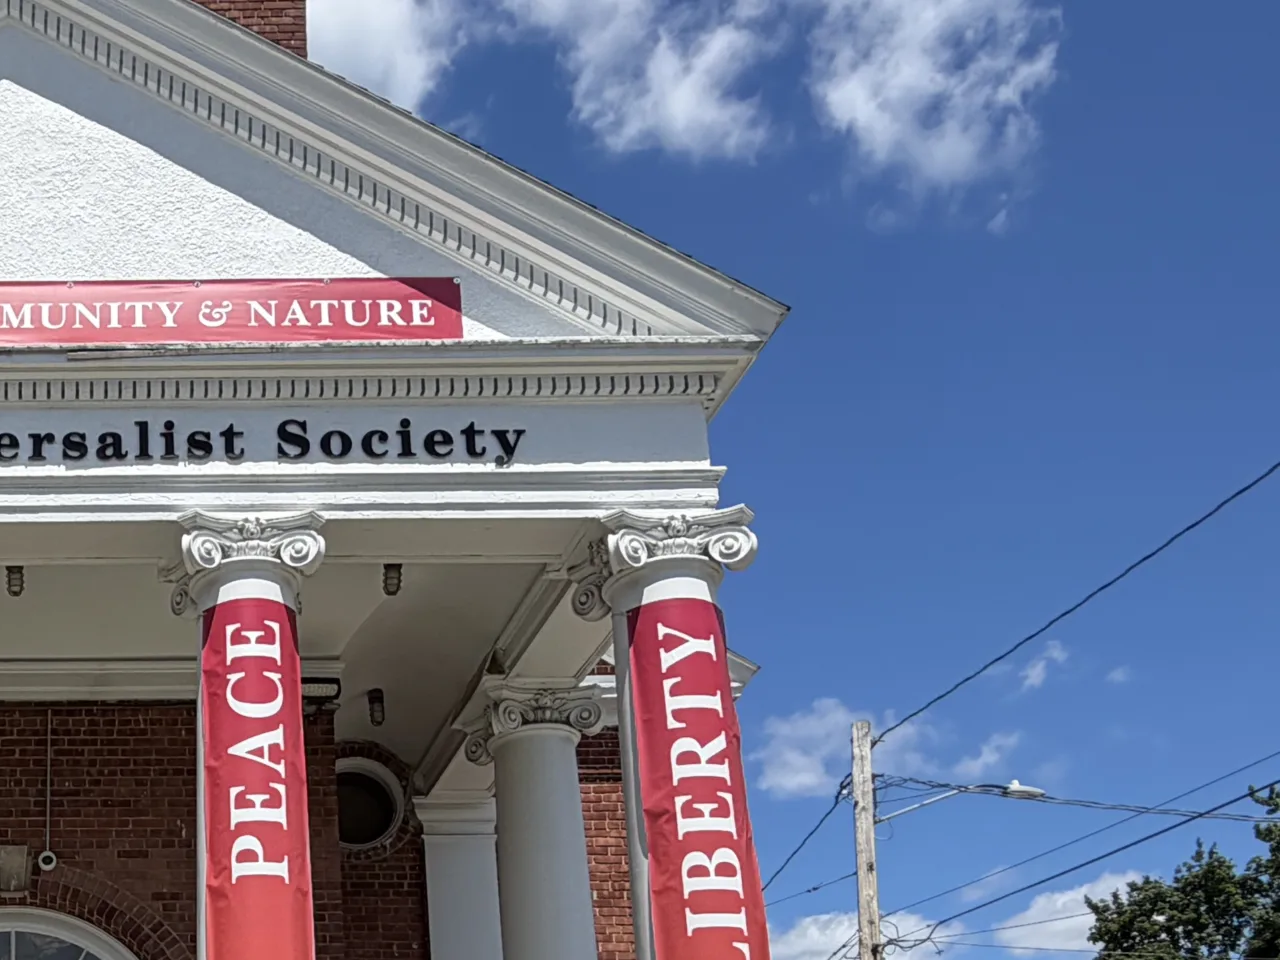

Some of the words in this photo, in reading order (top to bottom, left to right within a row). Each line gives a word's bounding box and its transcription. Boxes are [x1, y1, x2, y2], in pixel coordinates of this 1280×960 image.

[198, 299, 234, 328] &
[245, 298, 436, 328] NATURE
[276, 418, 527, 468] Society
[224, 620, 289, 884] PEACE
